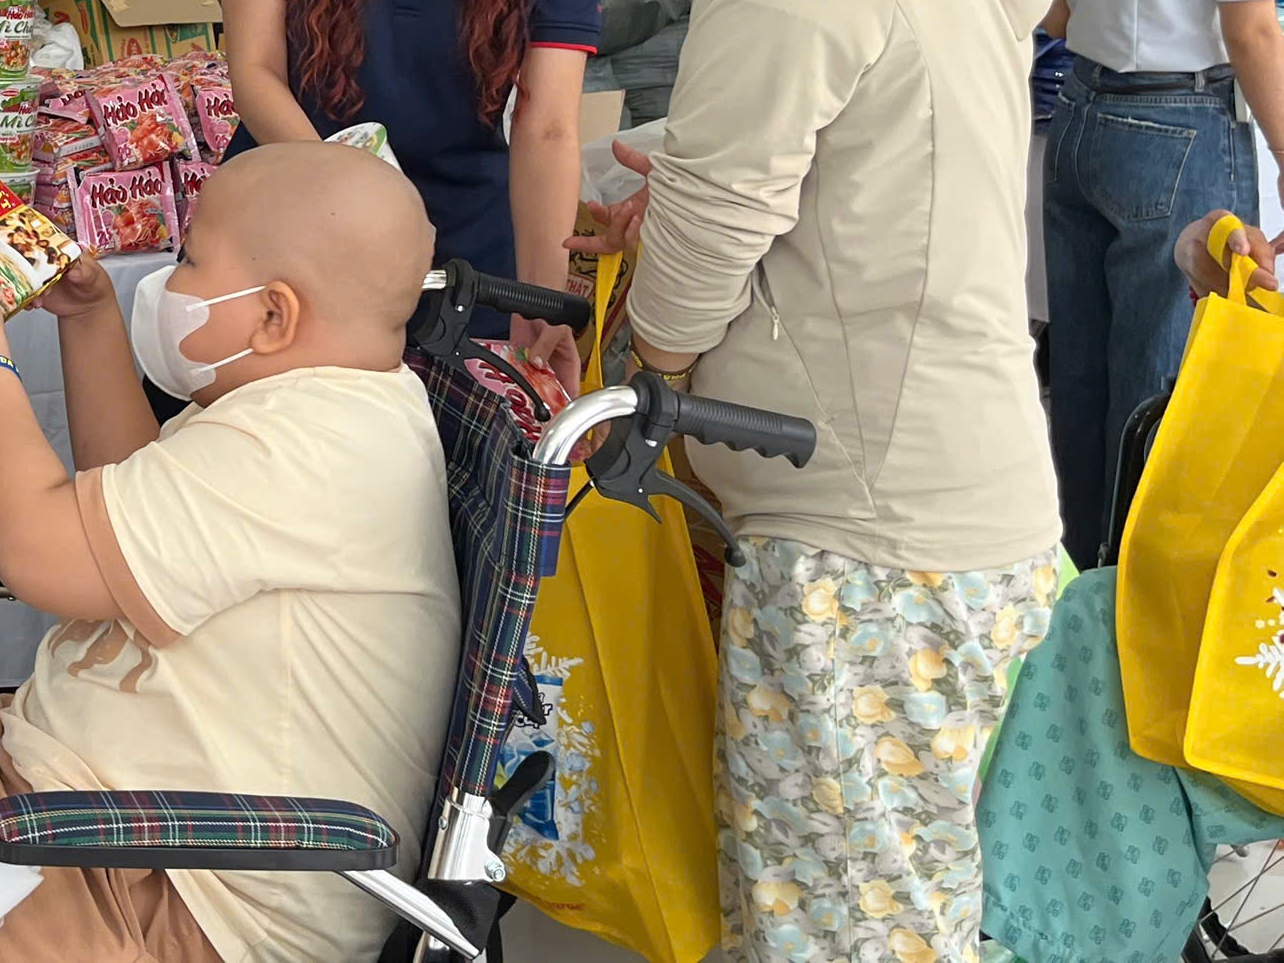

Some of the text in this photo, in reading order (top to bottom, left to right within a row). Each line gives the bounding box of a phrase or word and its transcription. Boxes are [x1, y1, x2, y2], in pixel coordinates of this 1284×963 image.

[0, 114, 22, 129] Mì
[103, 95, 138, 127] Hảo
[91, 171, 162, 209] Hảo Hảo
